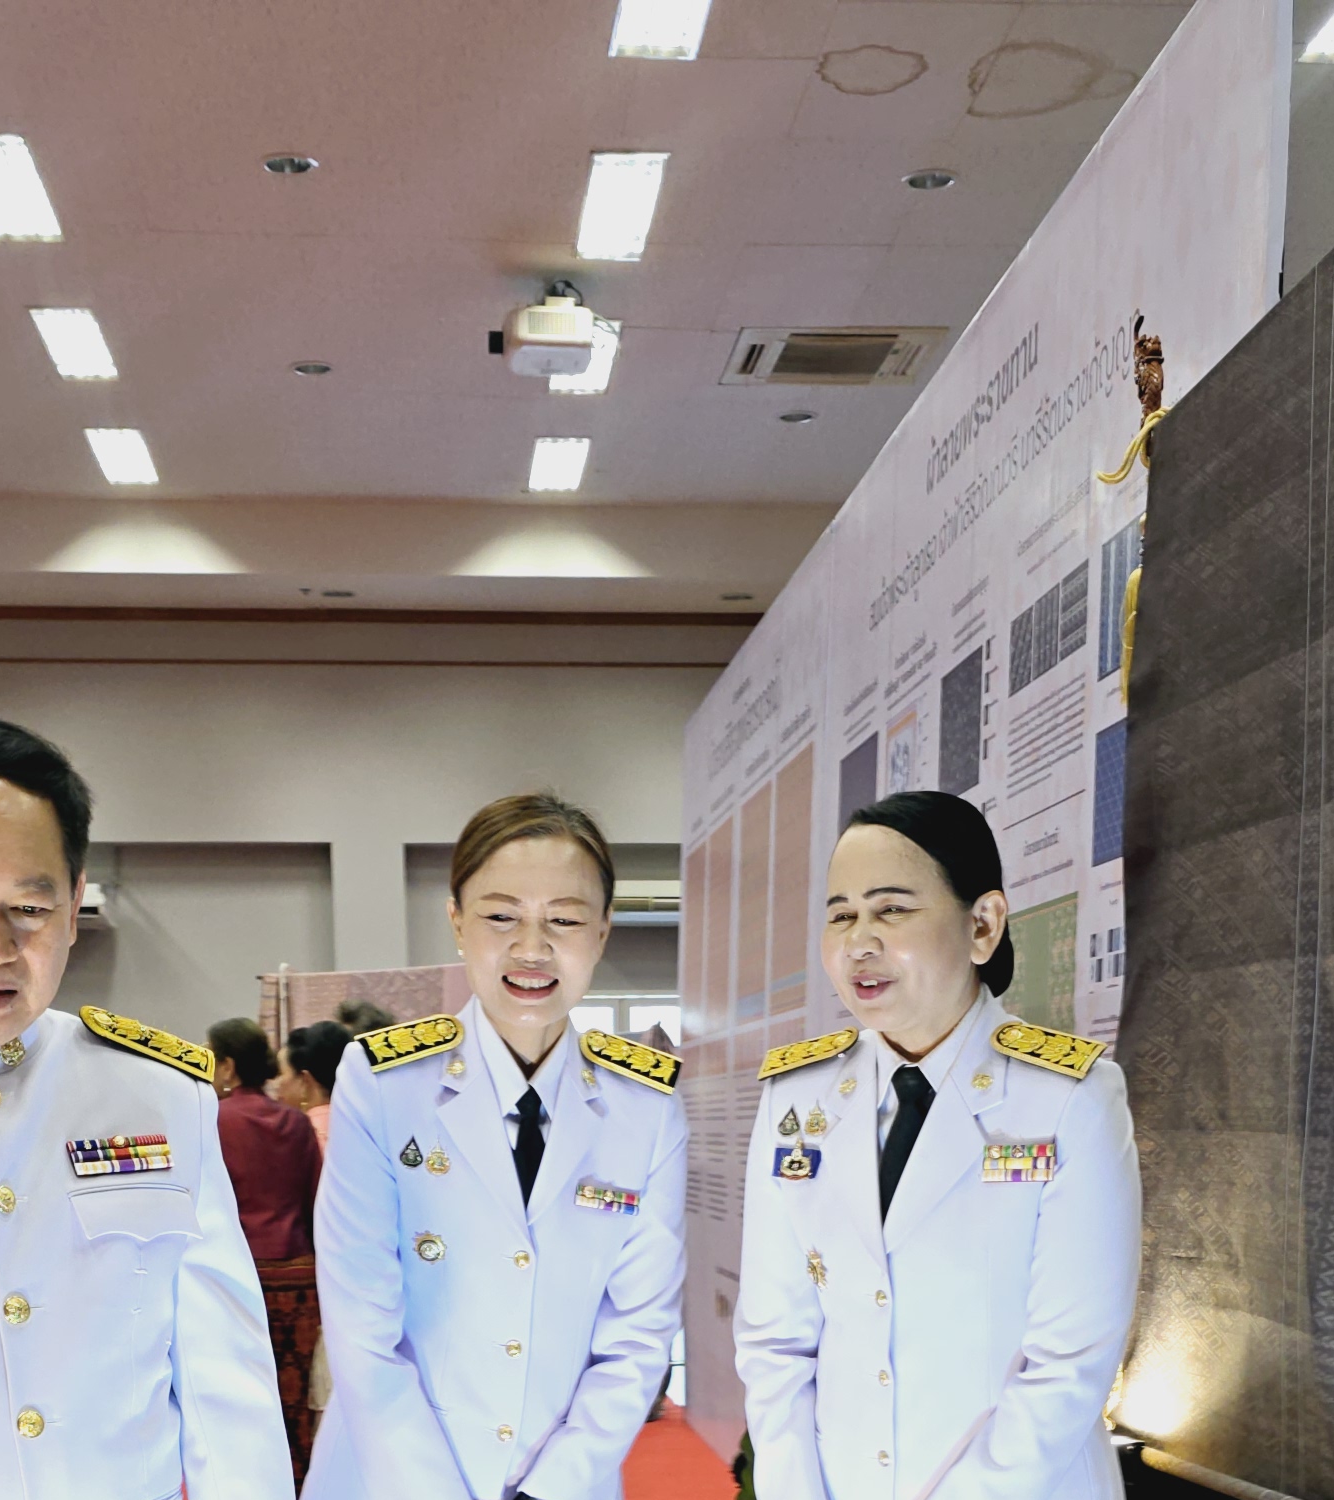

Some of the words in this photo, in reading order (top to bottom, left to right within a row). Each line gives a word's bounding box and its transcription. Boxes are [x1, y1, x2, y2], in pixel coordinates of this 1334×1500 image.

[927, 321, 1039, 494] ผ้าลายพระราชทาน
[1021, 307, 1140, 471] นารีรัตนราชกัญญ
